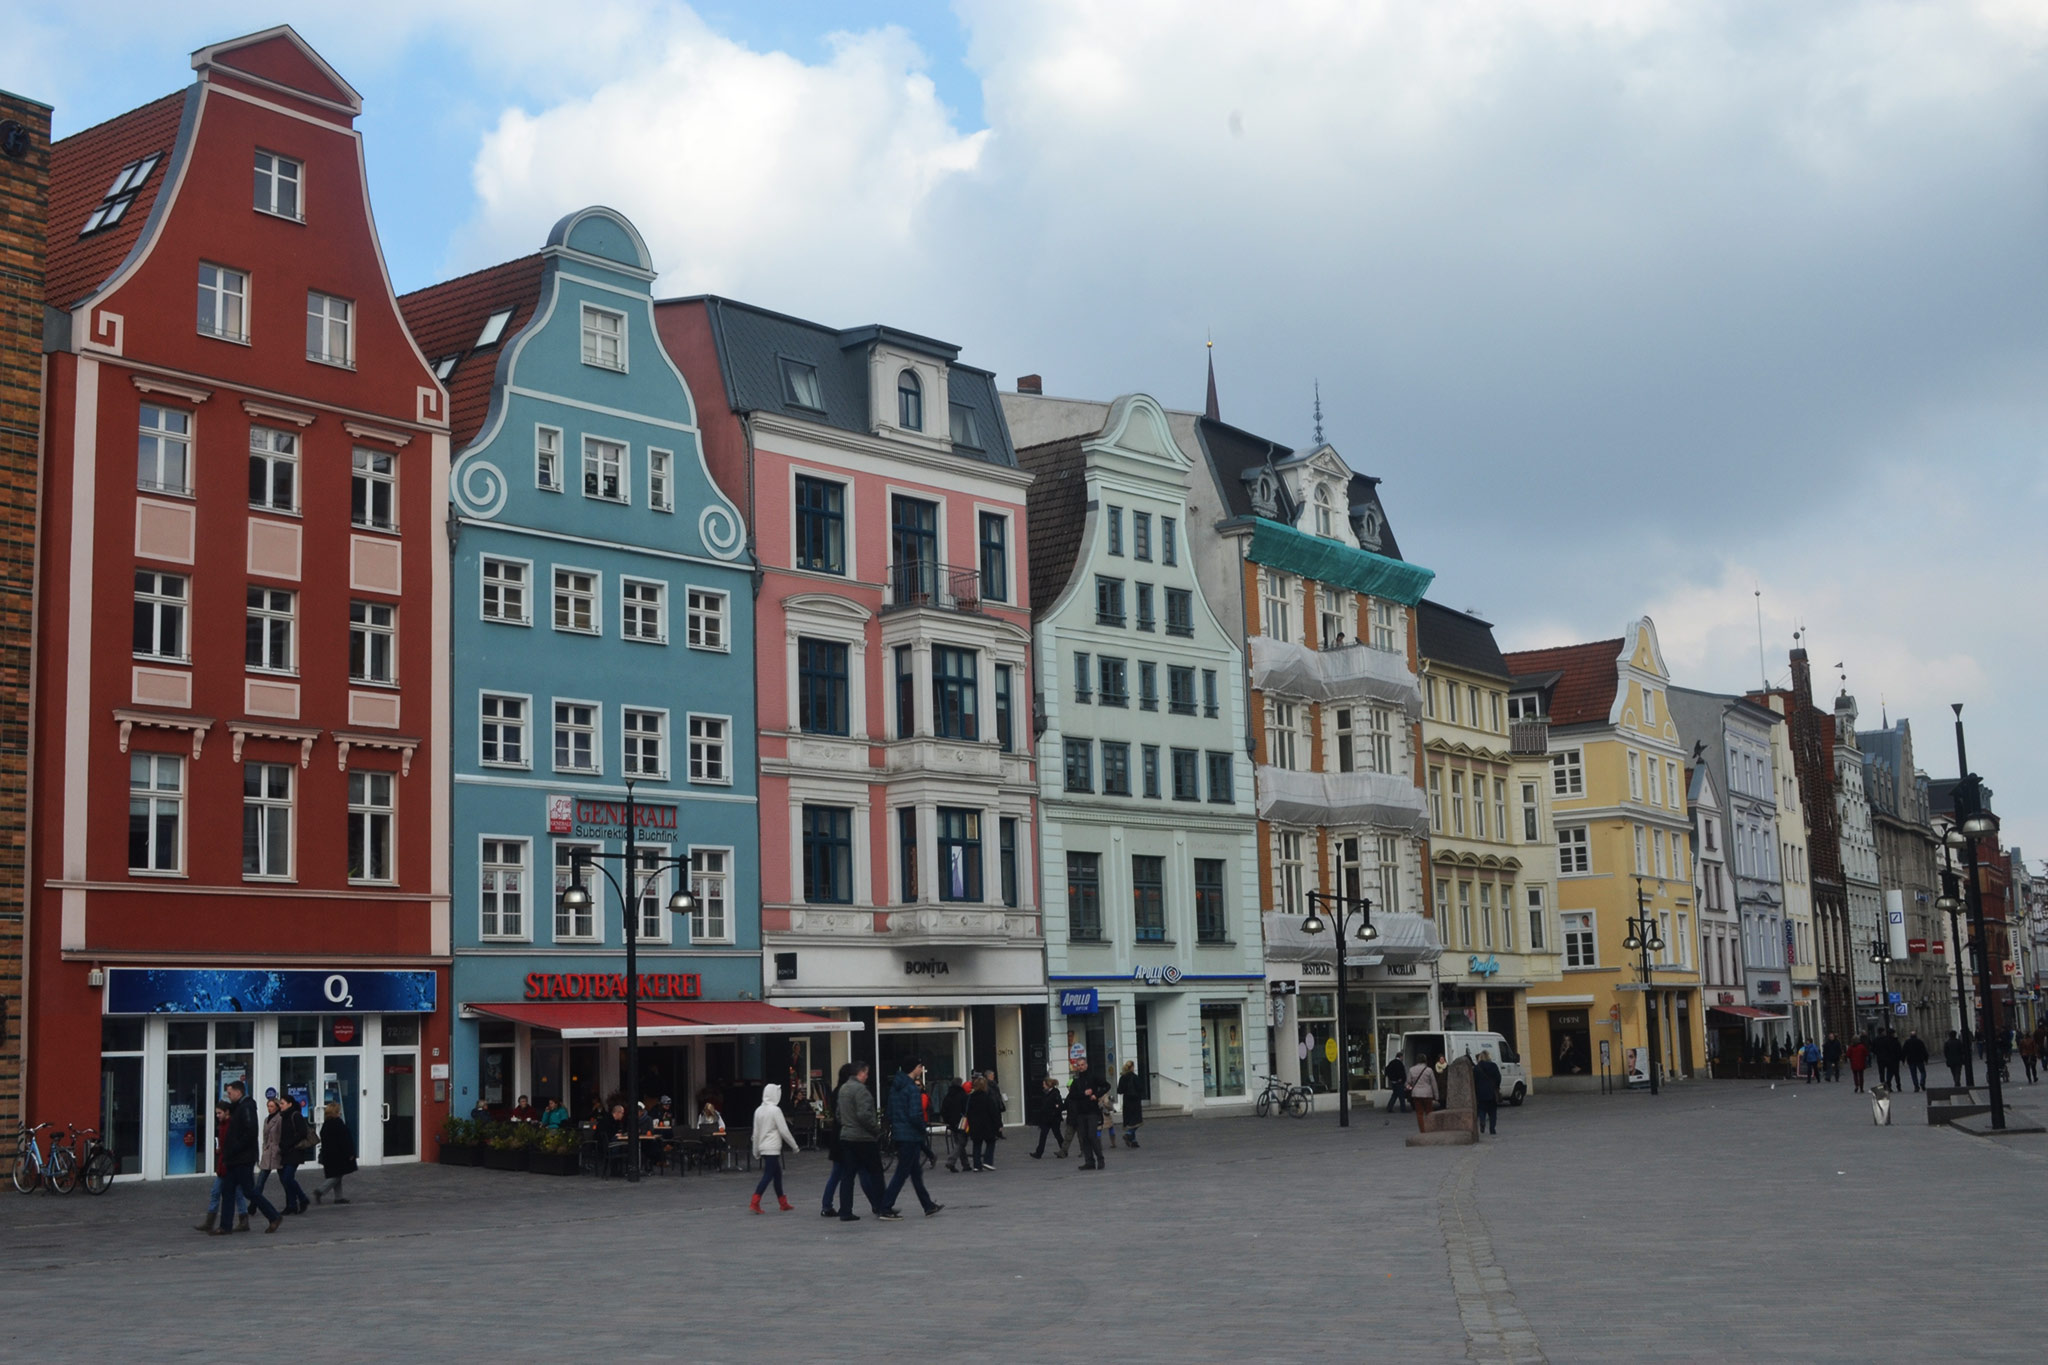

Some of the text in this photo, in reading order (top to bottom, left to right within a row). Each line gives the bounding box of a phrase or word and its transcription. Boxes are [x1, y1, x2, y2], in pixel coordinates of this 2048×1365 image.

[575, 799, 678, 829] GENERALI
[575, 825, 678, 842] Subdirektio Buchfink
[905, 958, 949, 978] BONITA
[1135, 965, 1163, 979] APOLLO
[1302, 963, 1331, 976] BESTECKE
[1062, 992, 1091, 1006] APOLLO
